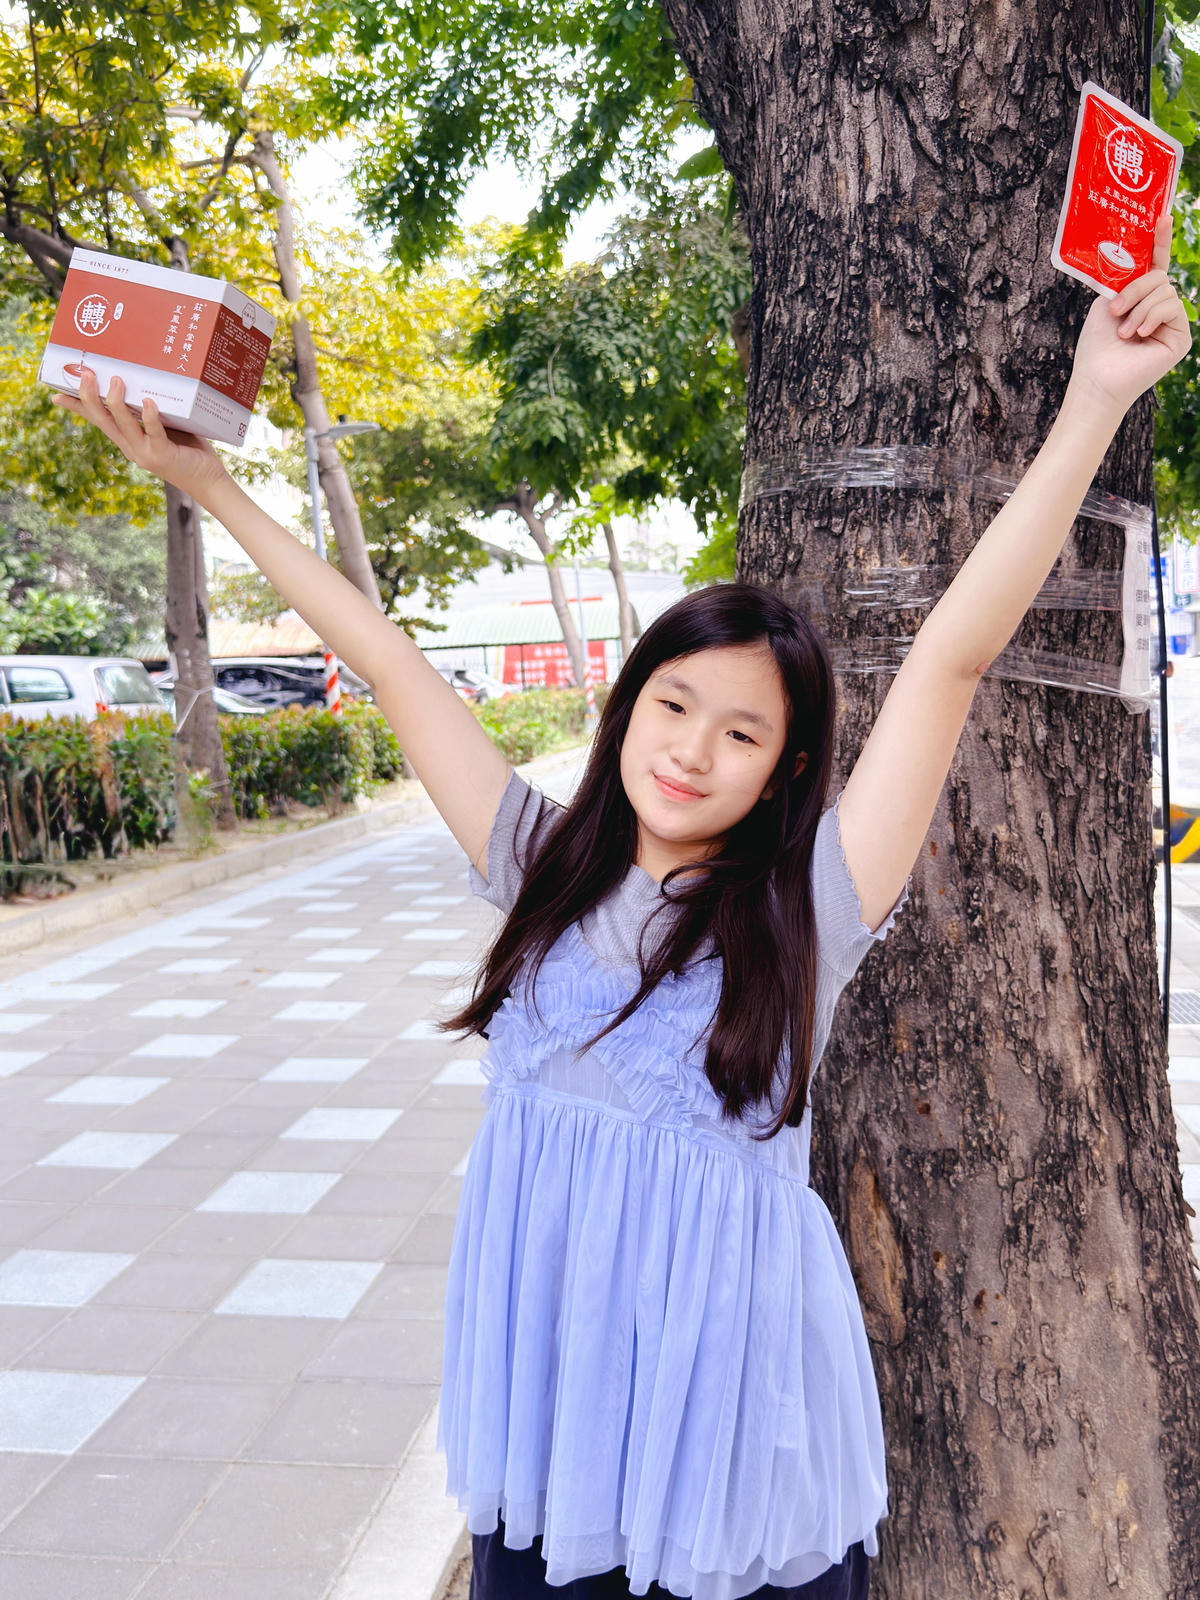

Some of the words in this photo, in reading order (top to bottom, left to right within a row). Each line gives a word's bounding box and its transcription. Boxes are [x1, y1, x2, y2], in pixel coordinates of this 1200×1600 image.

[1112, 134, 1144, 185] 轉
[89, 260, 111, 270] SINCE
[79, 300, 107, 331] 轉
